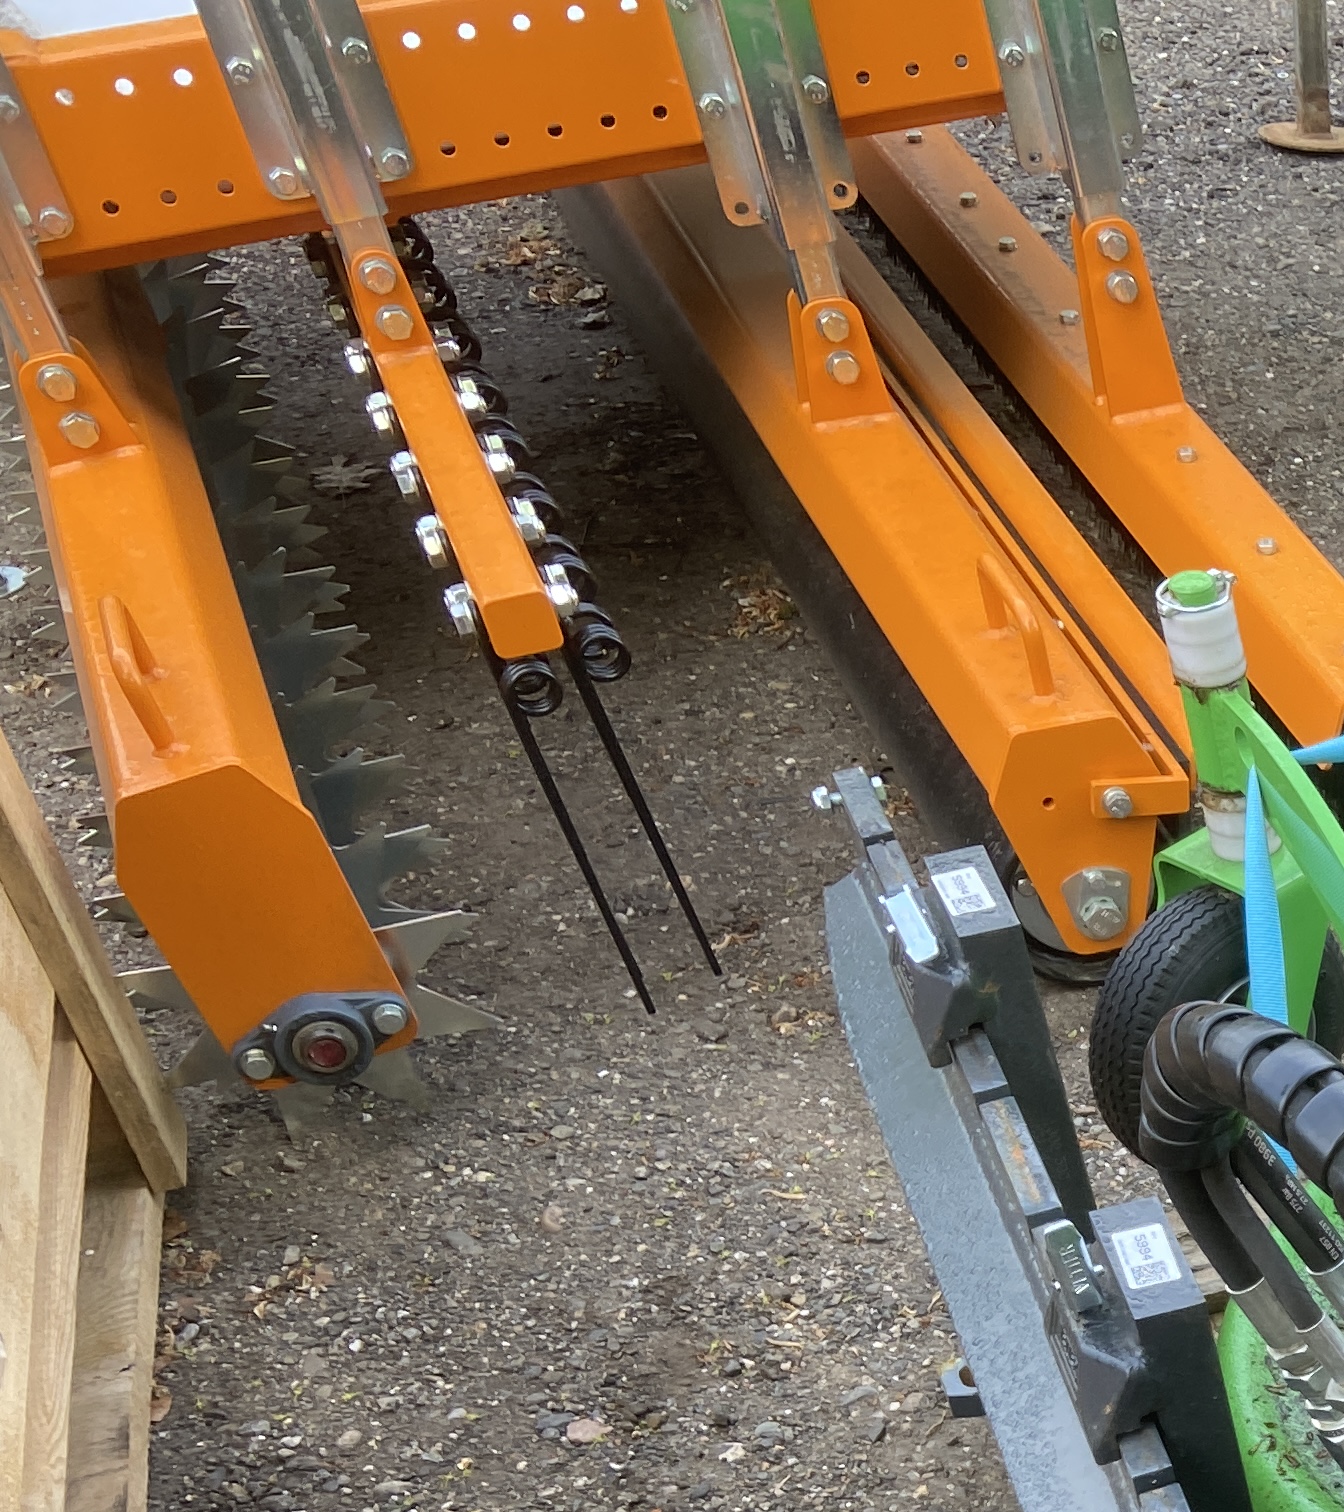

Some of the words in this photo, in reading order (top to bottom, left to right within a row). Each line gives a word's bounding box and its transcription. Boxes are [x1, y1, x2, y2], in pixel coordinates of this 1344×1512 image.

[1253, 1135, 1276, 1167] 3980
[1289, 1198, 1304, 1214] 275
[1134, 1233, 1154, 1262] 5994
